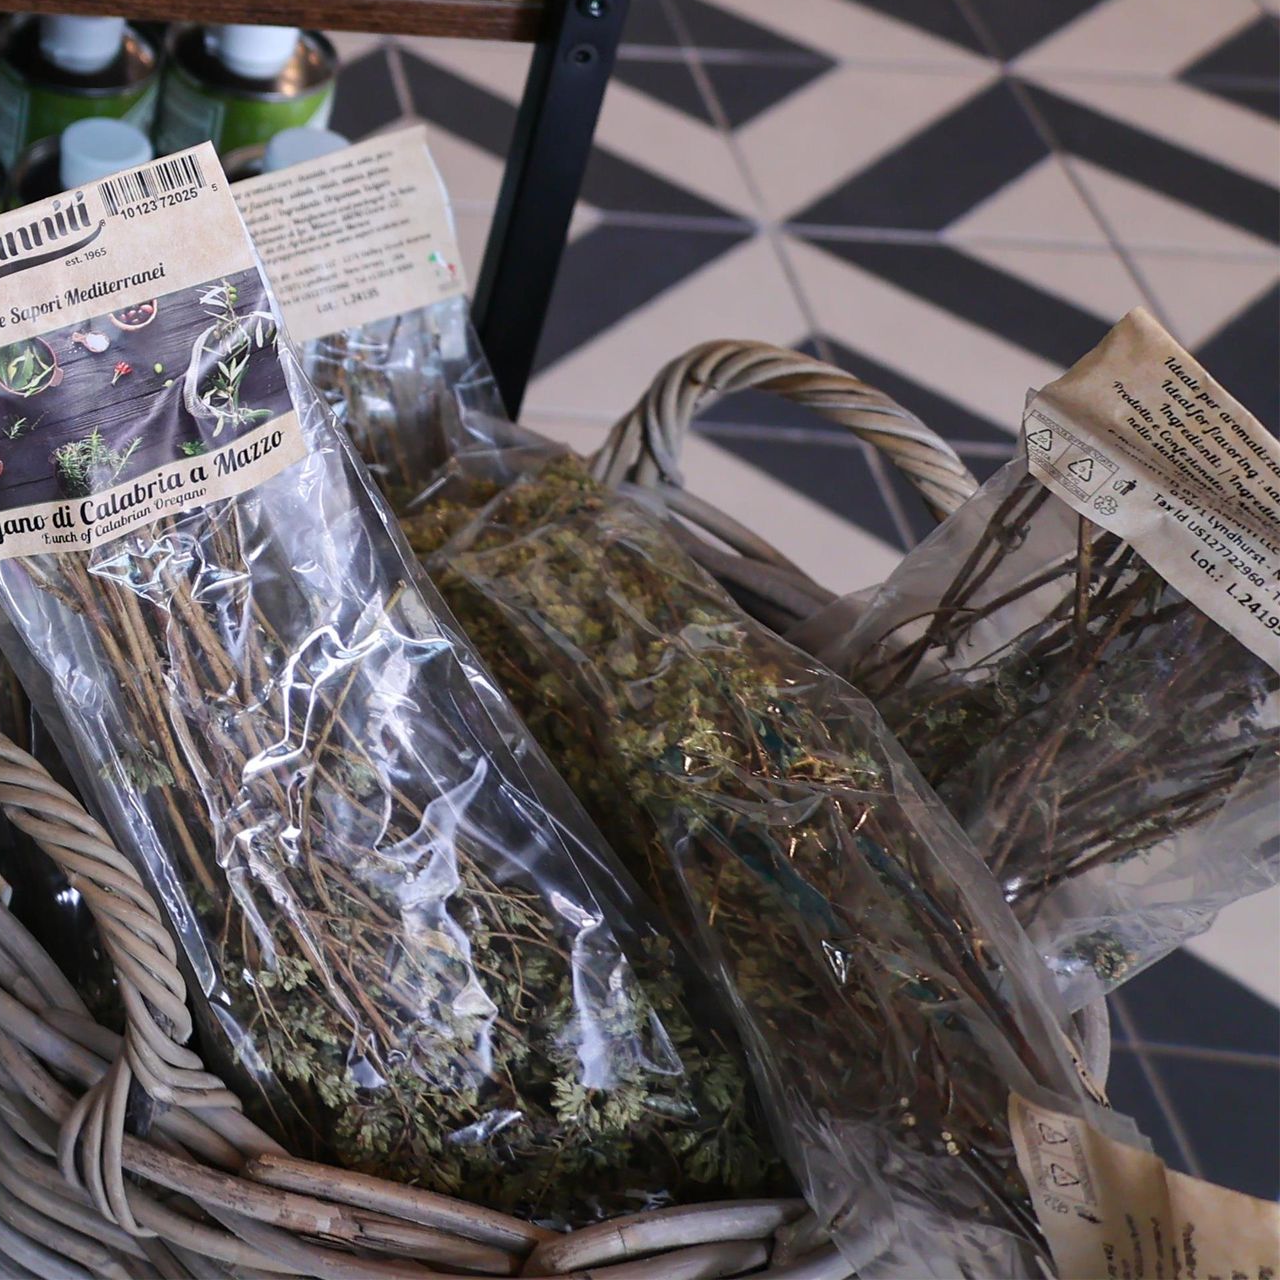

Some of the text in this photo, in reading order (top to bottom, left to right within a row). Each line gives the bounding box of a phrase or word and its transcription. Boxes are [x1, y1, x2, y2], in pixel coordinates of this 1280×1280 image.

[212, 183, 218, 192] 5
[65, 248, 108, 267] est. 1965
[0, 318, 7, 328] e
[11, 296, 62, 324] Sapori
[64, 262, 166, 307] Mediterranei
[1164, 356, 1221, 410] Ideale per
[1162, 379, 1259, 479] Ideal for flavoring
[52, 509, 75, 529] di
[78, 473, 186, 525] Calabria
[189, 466, 209, 483] a
[213, 429, 285, 478] Mazzo
[81, 529, 92, 543] of
[94, 507, 151, 537] Calabrian
[152, 487, 207, 512] Oregano
[1153, 493, 1174, 512] Tax
[1173, 509, 1189, 523] Id
